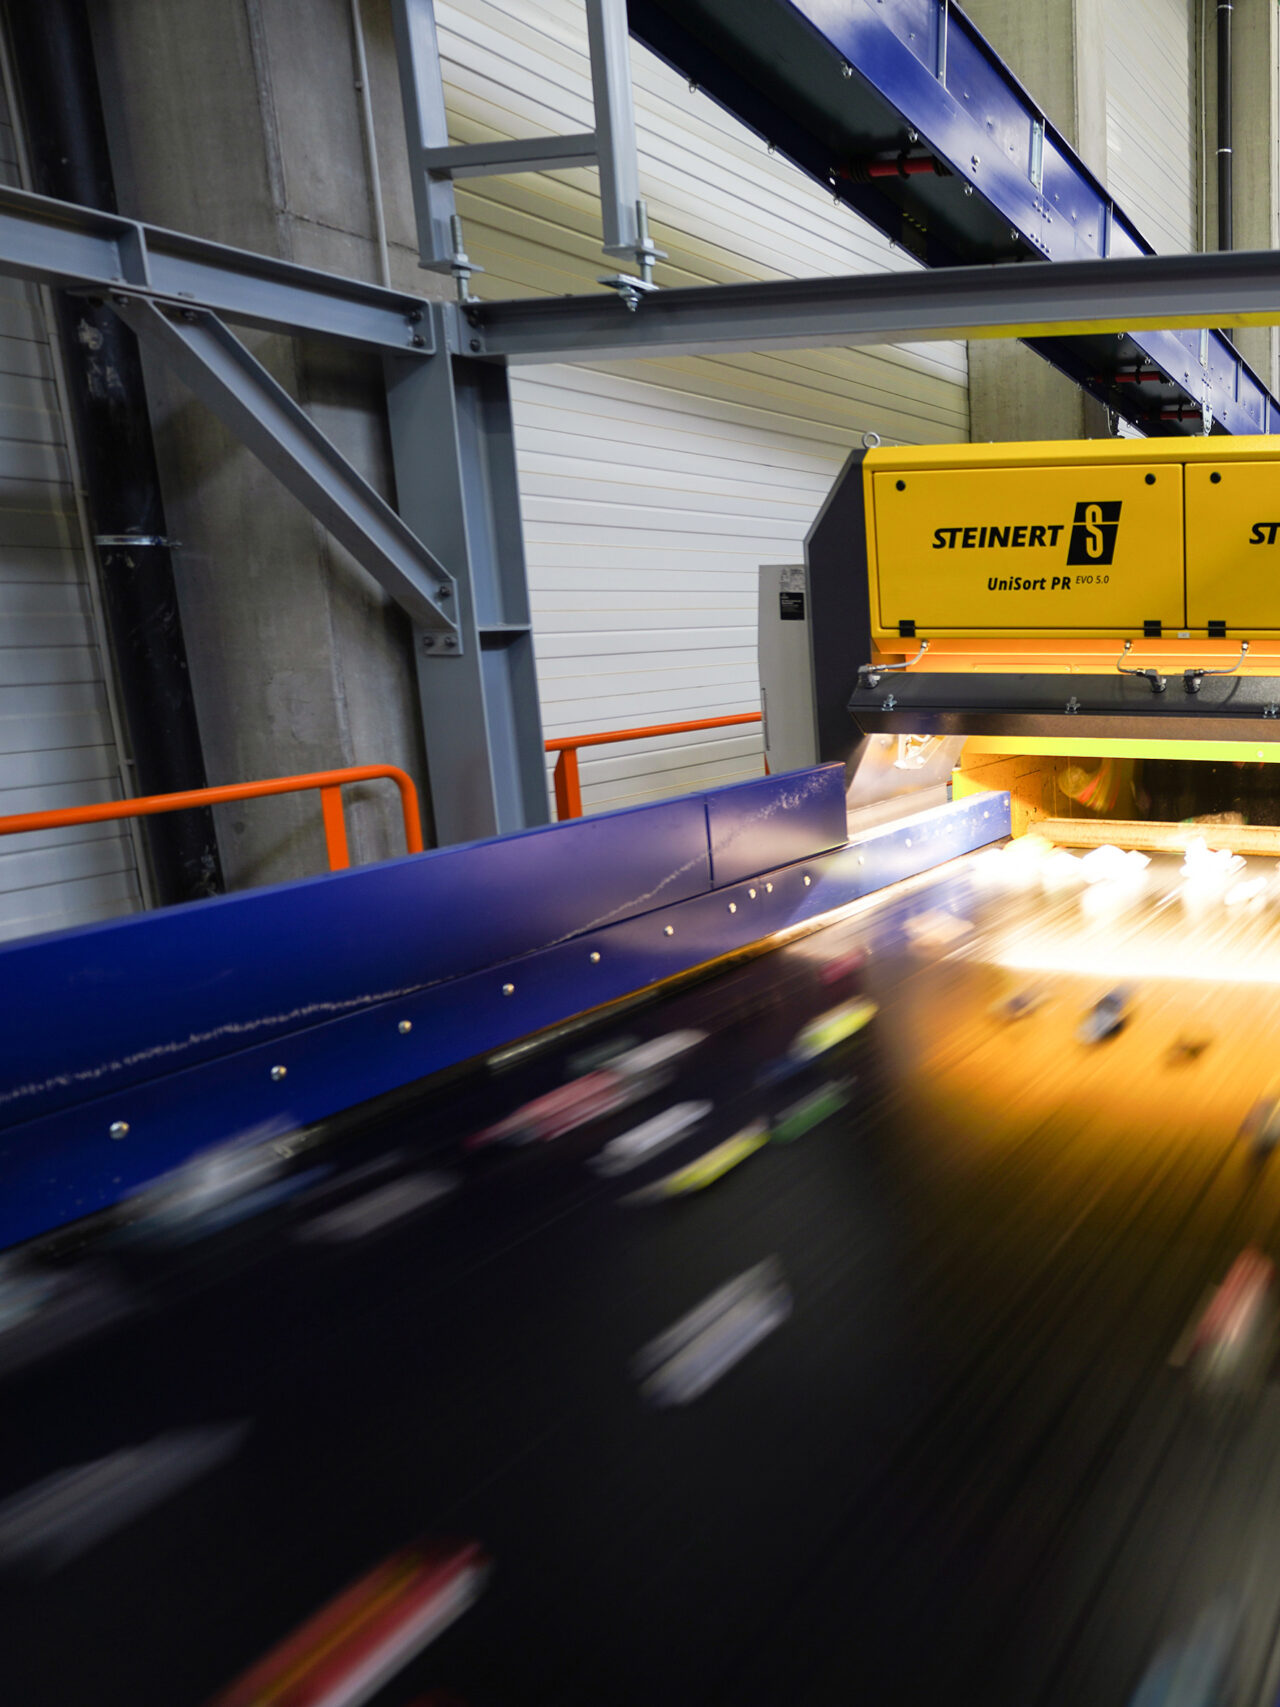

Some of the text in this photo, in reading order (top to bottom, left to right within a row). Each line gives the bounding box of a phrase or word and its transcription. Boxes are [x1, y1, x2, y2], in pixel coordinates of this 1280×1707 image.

[932, 525, 1065, 549] STEINERT
[987, 575, 1110, 591] UniSort PR EVO 5.0
